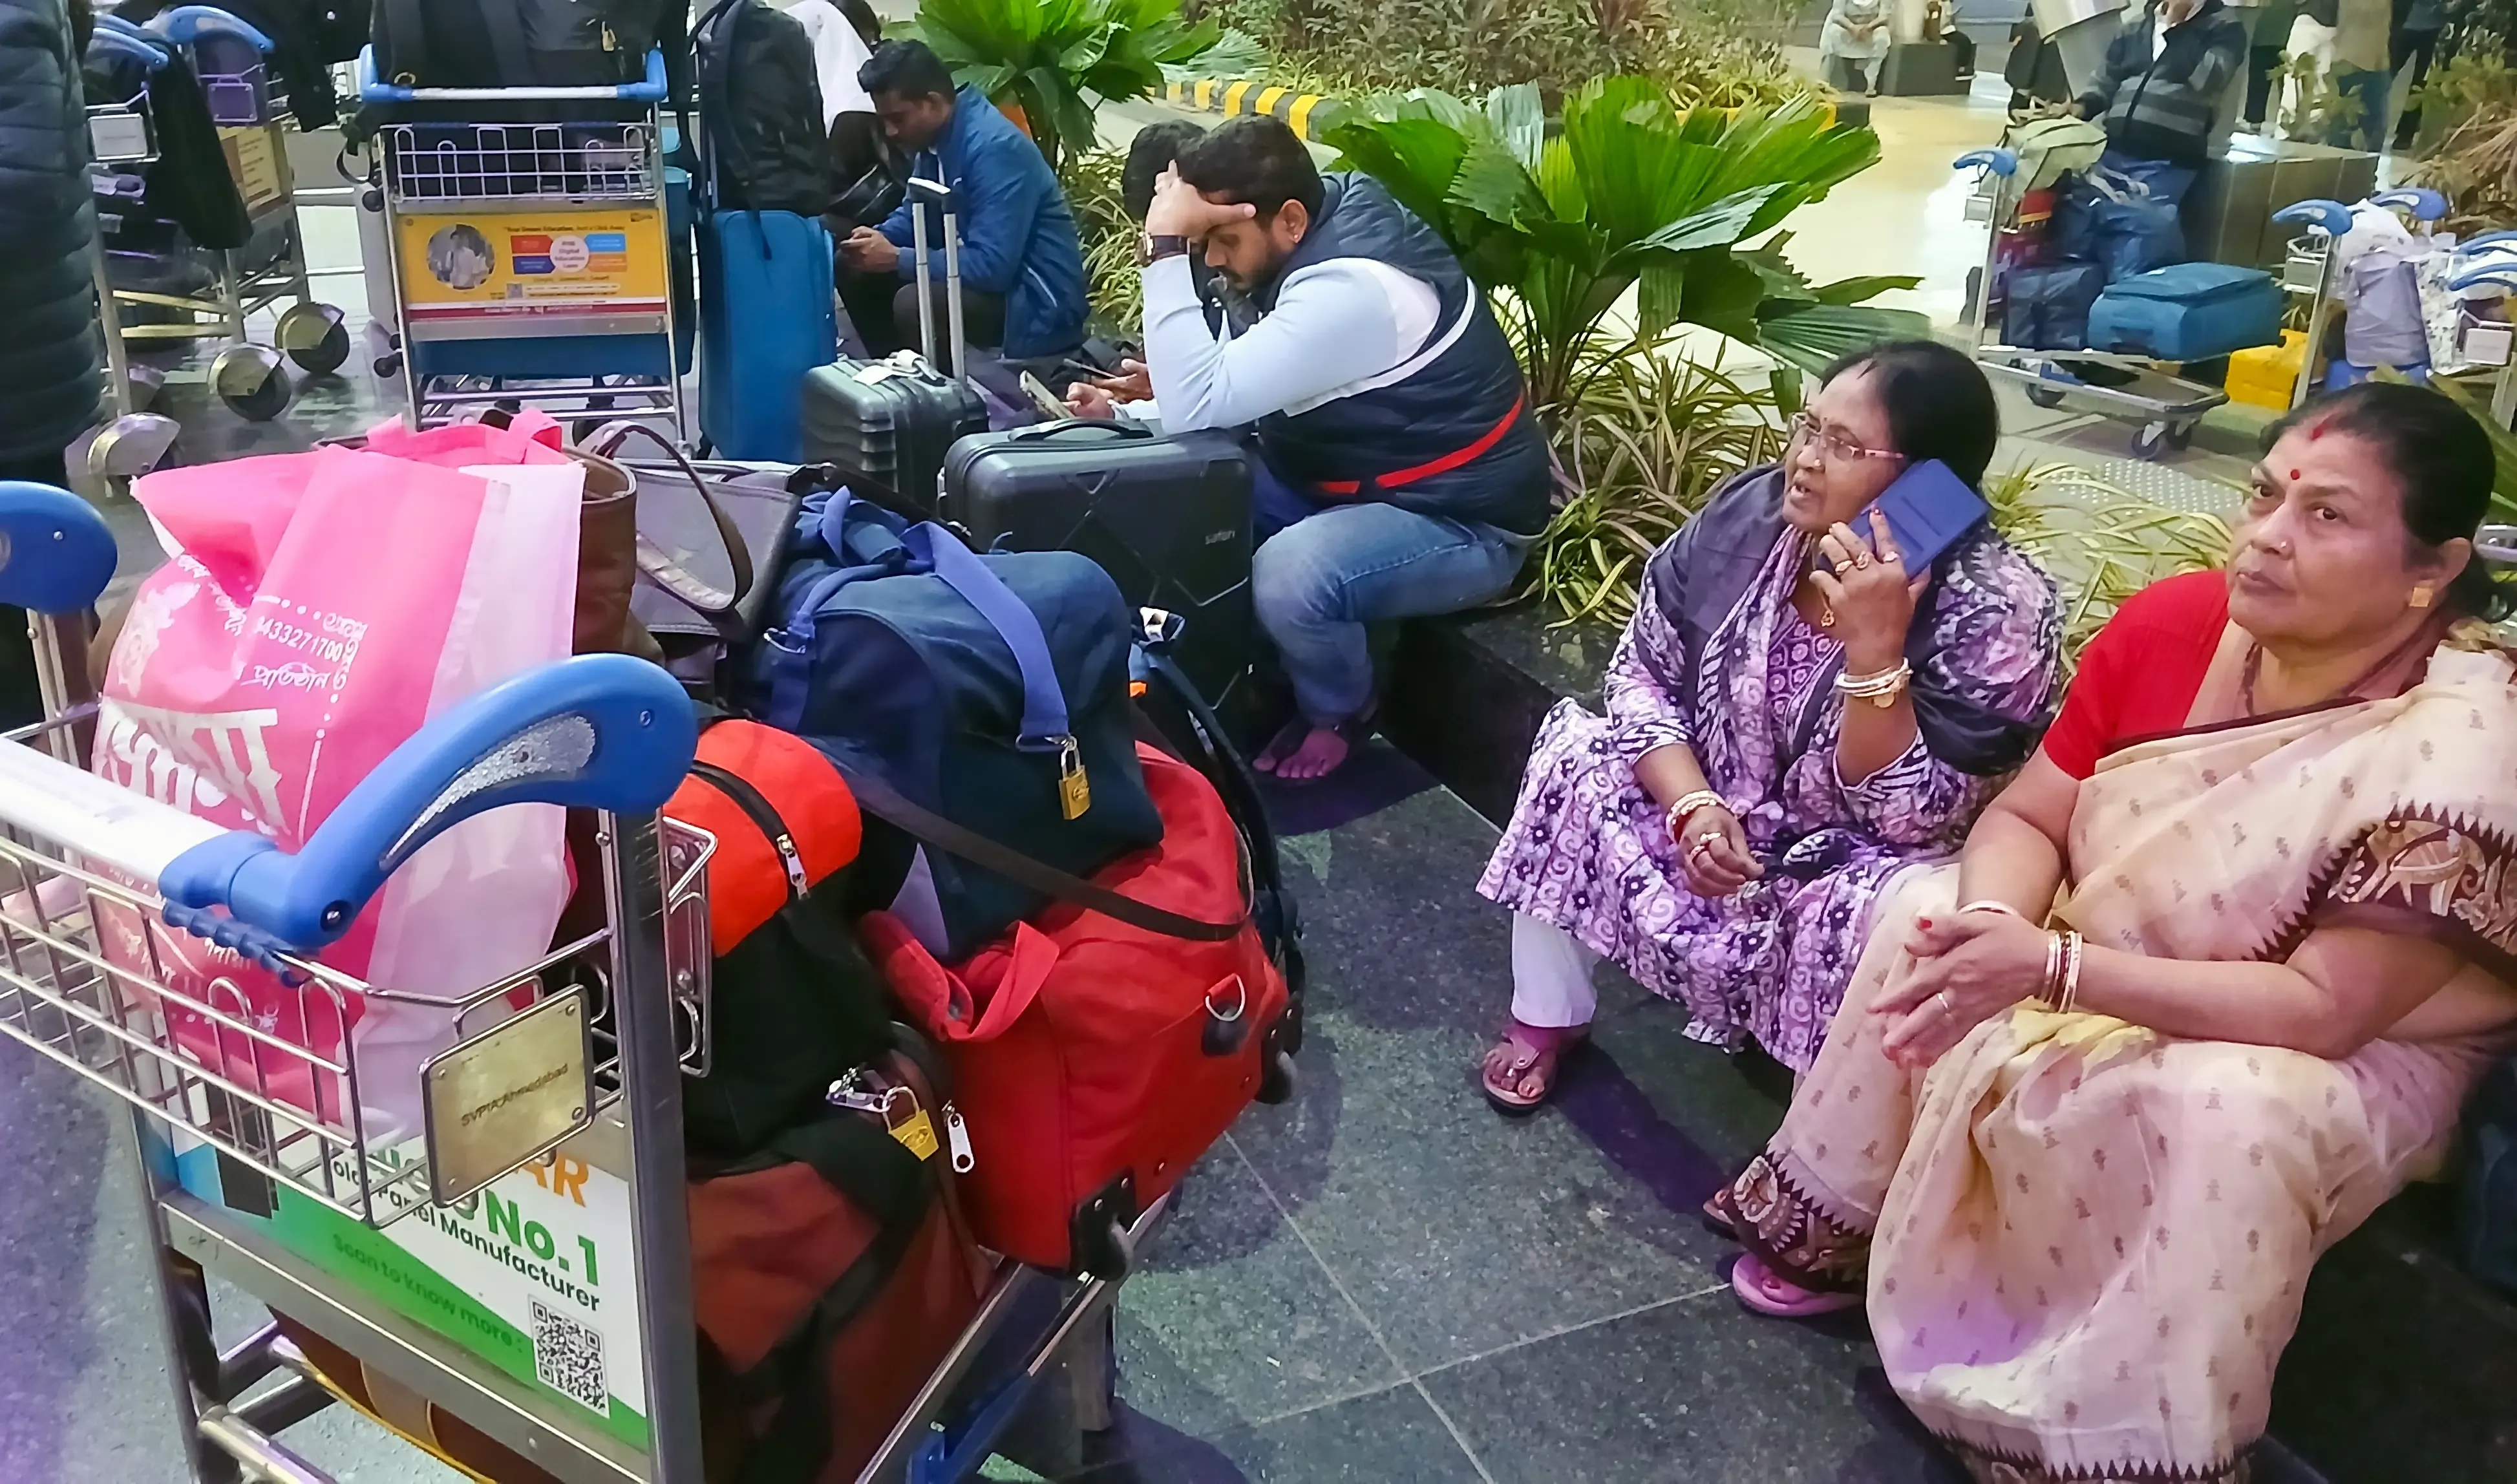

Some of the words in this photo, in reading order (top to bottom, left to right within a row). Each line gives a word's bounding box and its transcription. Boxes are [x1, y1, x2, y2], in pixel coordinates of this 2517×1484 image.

[333, 1233, 378, 1272] Scan
[381, 1262, 401, 1284] to
[403, 1272, 456, 1315] know
[440, 1212, 600, 1311] Manufacturer
